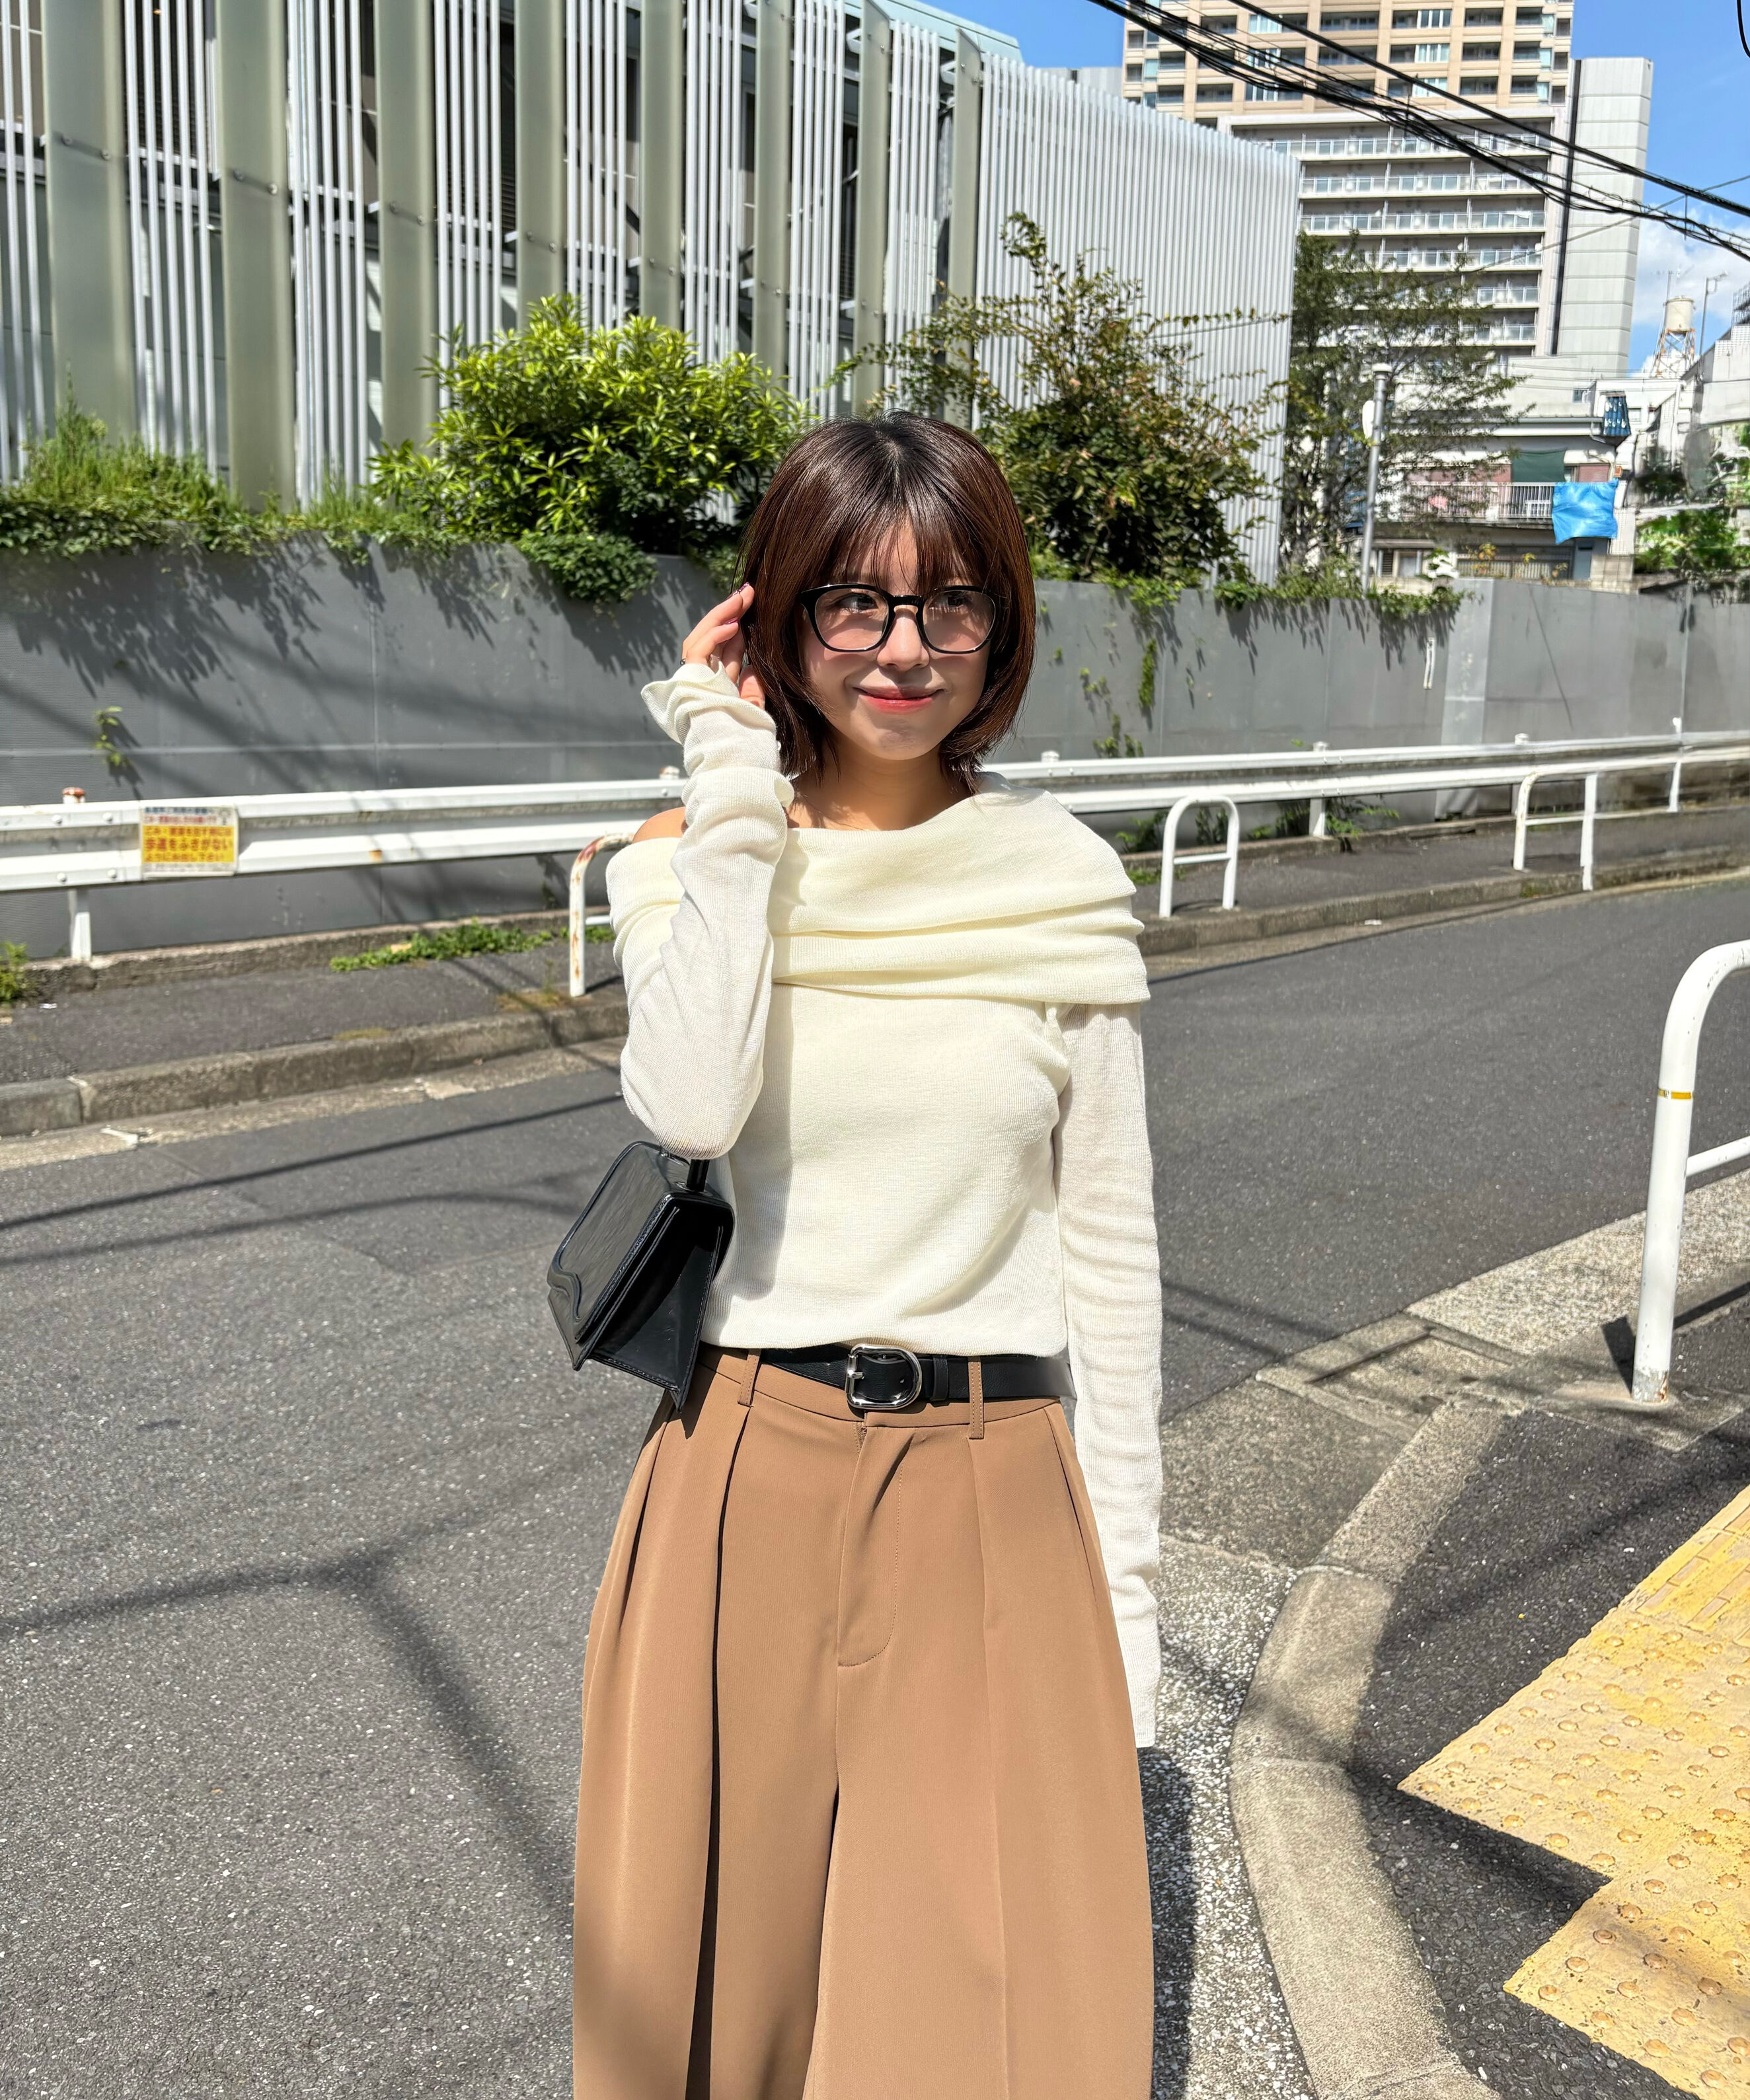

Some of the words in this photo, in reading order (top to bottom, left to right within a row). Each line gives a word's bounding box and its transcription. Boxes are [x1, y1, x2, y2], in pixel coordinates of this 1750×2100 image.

[145, 837, 234, 851] 歩道をふさがない
